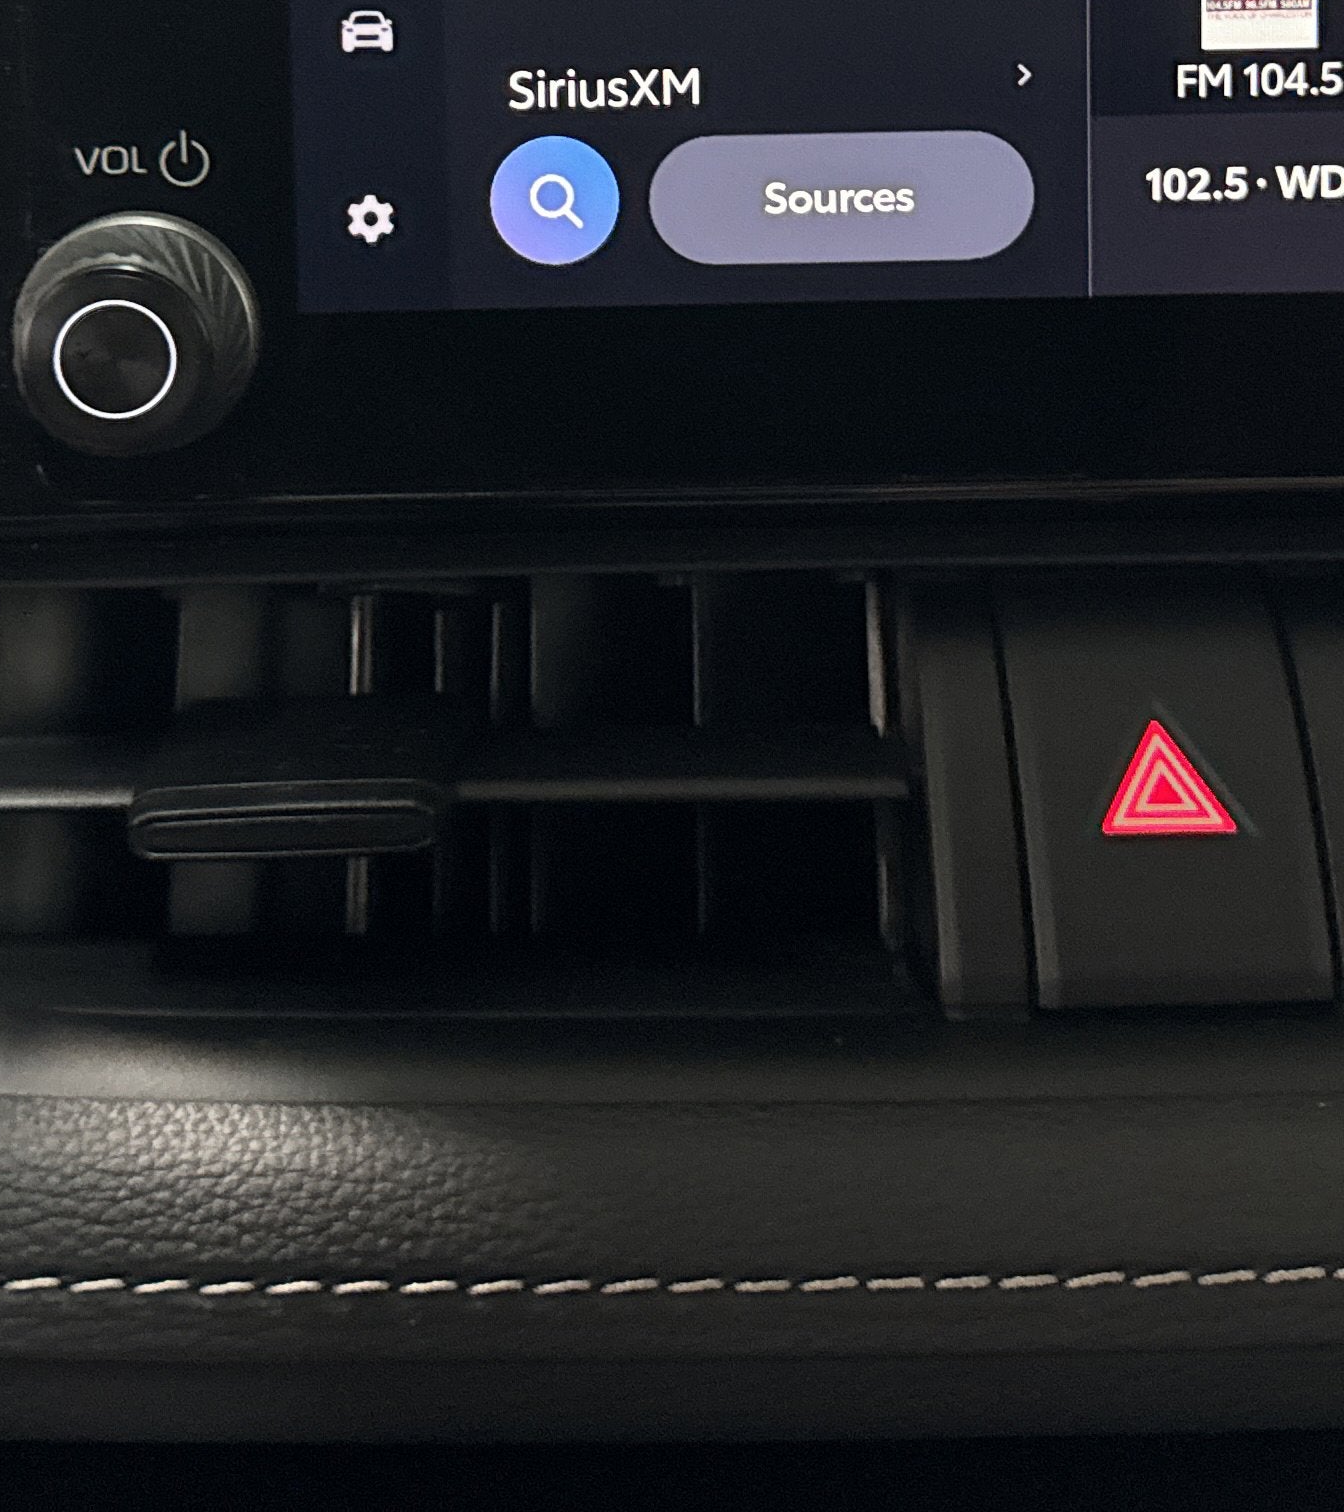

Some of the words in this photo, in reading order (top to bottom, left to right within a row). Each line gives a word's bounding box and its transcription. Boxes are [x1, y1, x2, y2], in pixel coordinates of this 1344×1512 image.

[508, 67, 700, 110] SiriusXM
[1177, 63, 1233, 99] FM
[1243, 61, 1344, 97] 104.5
[74, 145, 147, 175] VOL
[764, 181, 915, 215] Sources
[1145, 166, 1249, 202] 102.5
